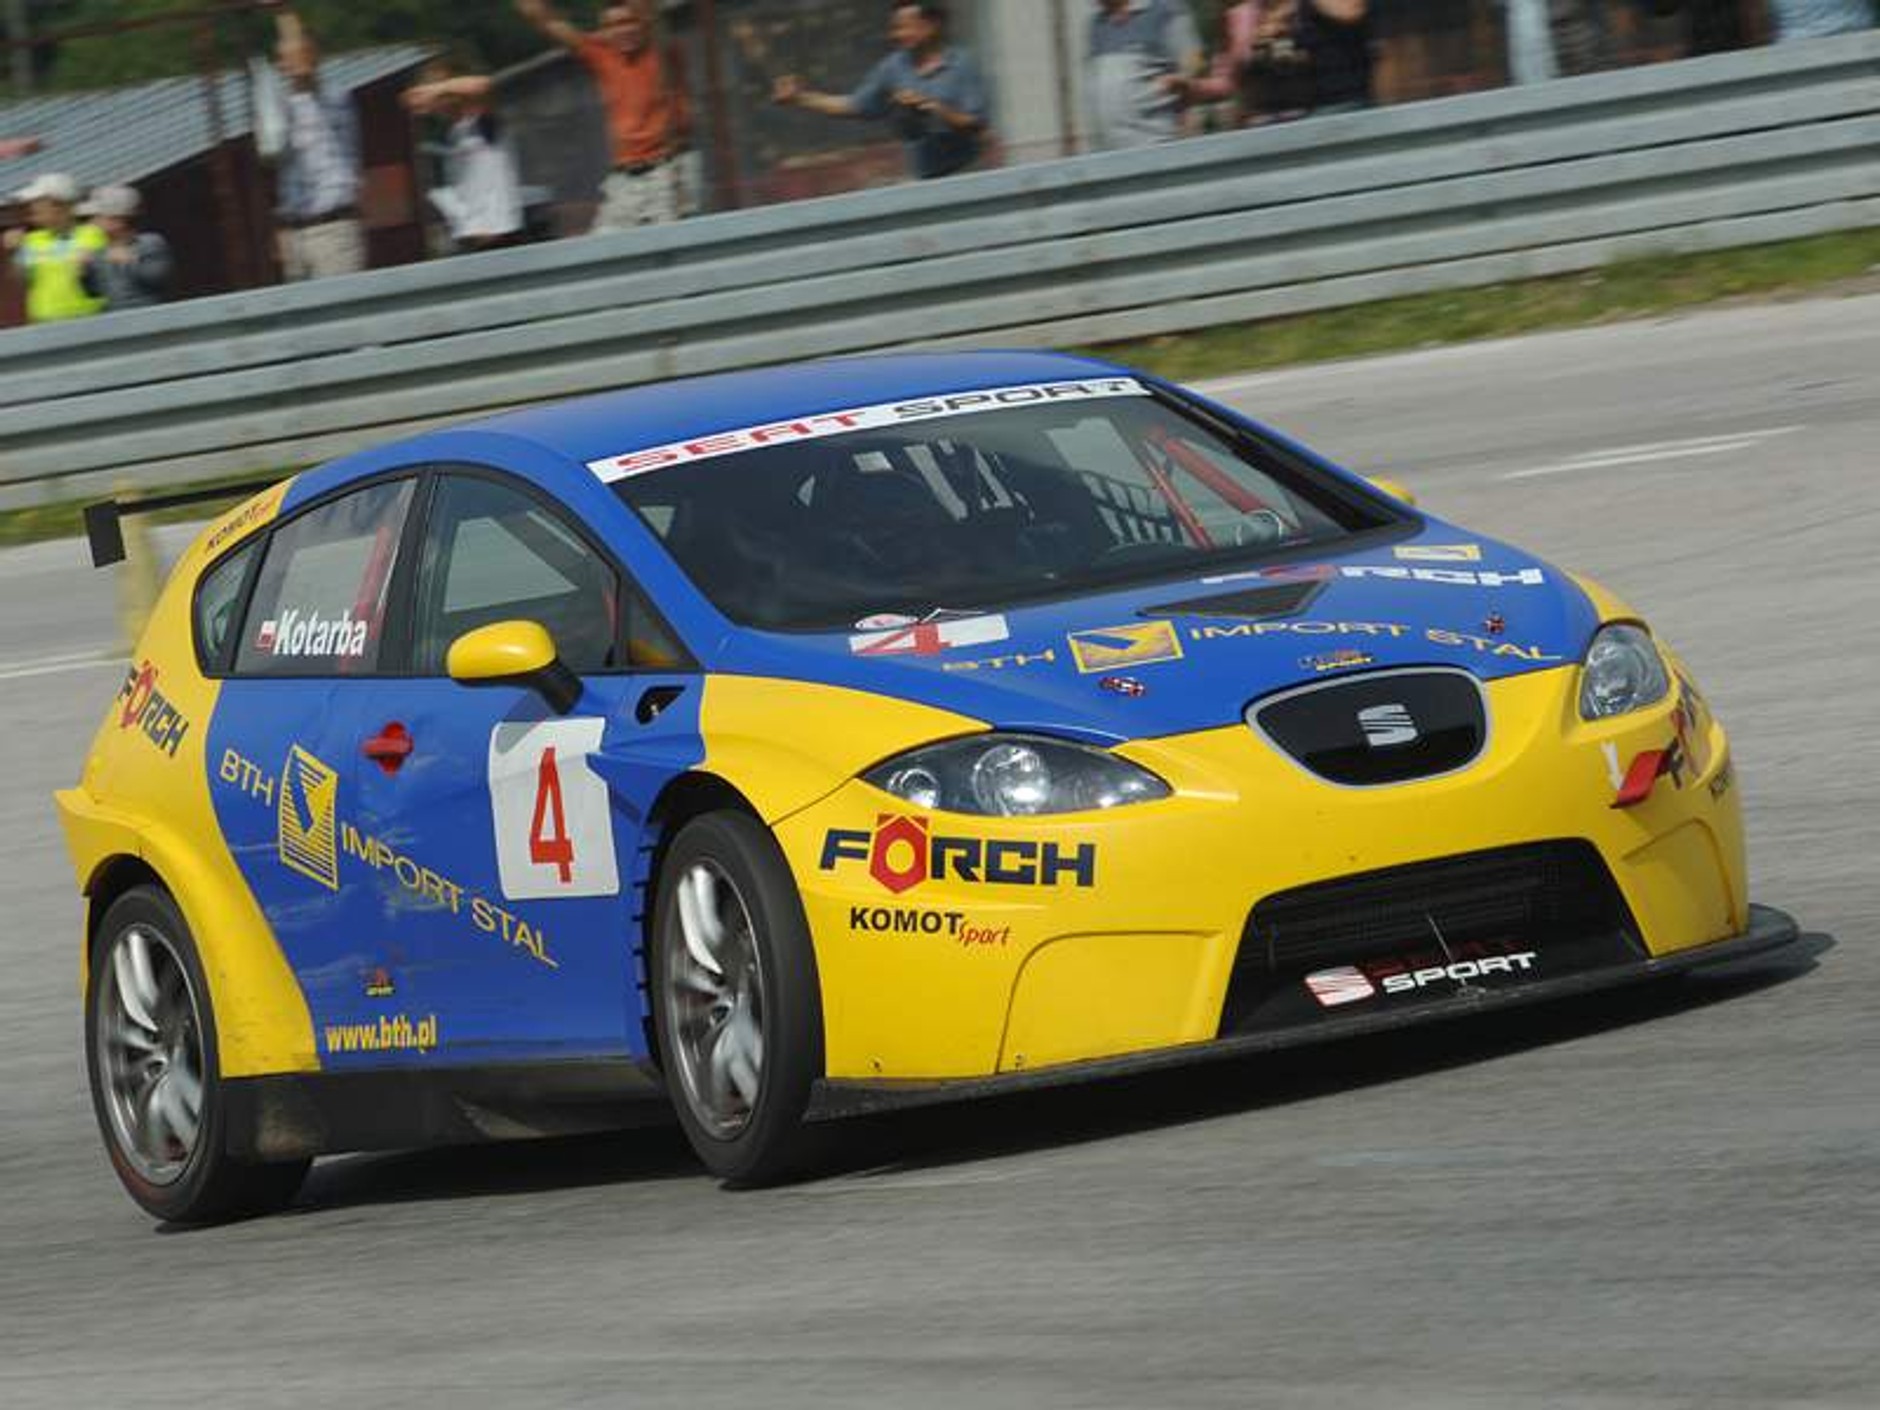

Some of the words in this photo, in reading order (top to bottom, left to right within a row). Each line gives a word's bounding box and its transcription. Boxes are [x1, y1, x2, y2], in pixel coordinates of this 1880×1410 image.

[616, 410, 866, 472] SEAT
[896, 378, 1136, 419] SPORT
[272, 609, 367, 655] Kotarba
[1190, 621, 1411, 641] IMPORT
[1424, 629, 1563, 661] STAL
[529, 746, 574, 883] 4
[219, 748, 275, 806] BTH
[341, 822, 464, 914] IMPORT
[471, 897, 560, 968] STAL
[1382, 951, 1537, 993] SPORT
[325, 1015, 438, 1054] www.bth.pl
